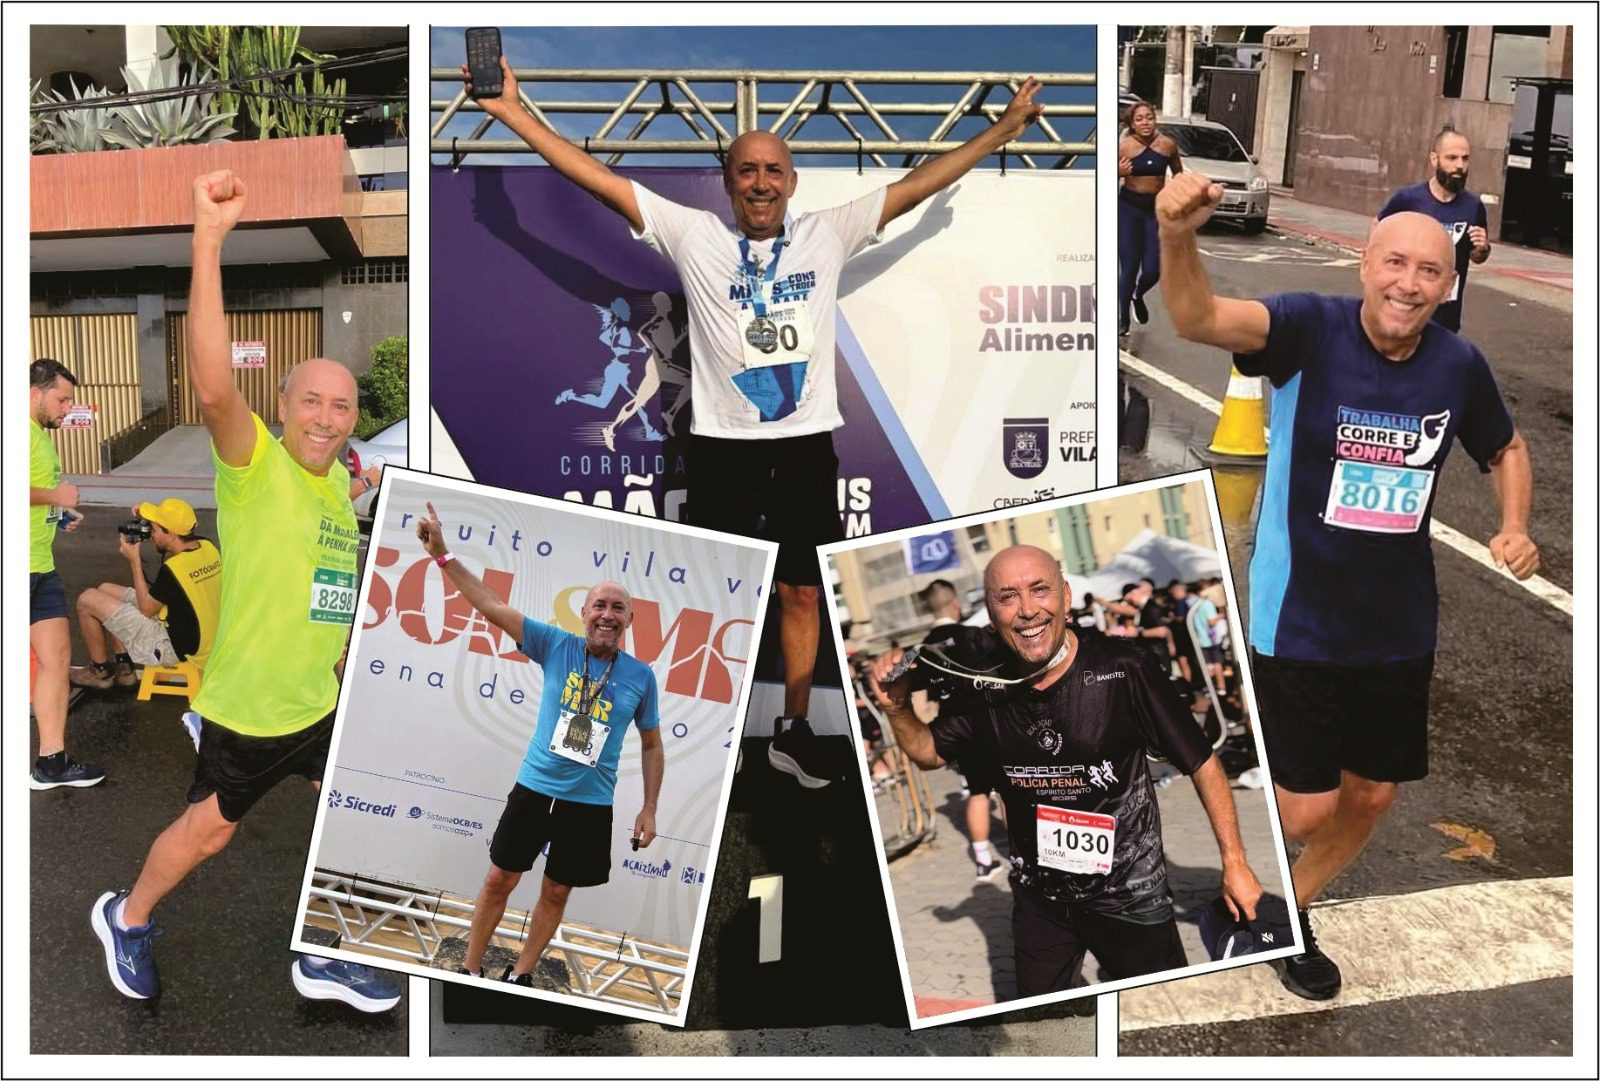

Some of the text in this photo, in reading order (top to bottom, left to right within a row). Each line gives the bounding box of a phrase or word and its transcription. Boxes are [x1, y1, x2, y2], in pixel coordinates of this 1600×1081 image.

[787, 270, 816, 285] CONS
[979, 327, 1095, 352] Alimen
[1341, 409, 1420, 432] TRABALHA
[1340, 426, 1412, 446] CORRE E
[1340, 442, 1405, 463] CONFIA
[560, 455, 686, 475] CORRIDA
[1339, 483, 1420, 514] 8016
[319, 519, 332, 534] DA
[401, 512, 553, 556] ruito
[593, 551, 686, 585] vila
[318, 588, 353, 612] 8298
[479, 672, 525, 705] de
[1002, 764, 1085, 775] CORRIDA
[1011, 776, 1087, 788] POLÍCIA PENAL
[1067, 787, 1092, 796] SANTO
[344, 796, 397, 818] Sicredi
[1053, 828, 1109, 855] 1030
[1043, 848, 1066, 858] 10KM
[748, 874, 783, 964] 1
